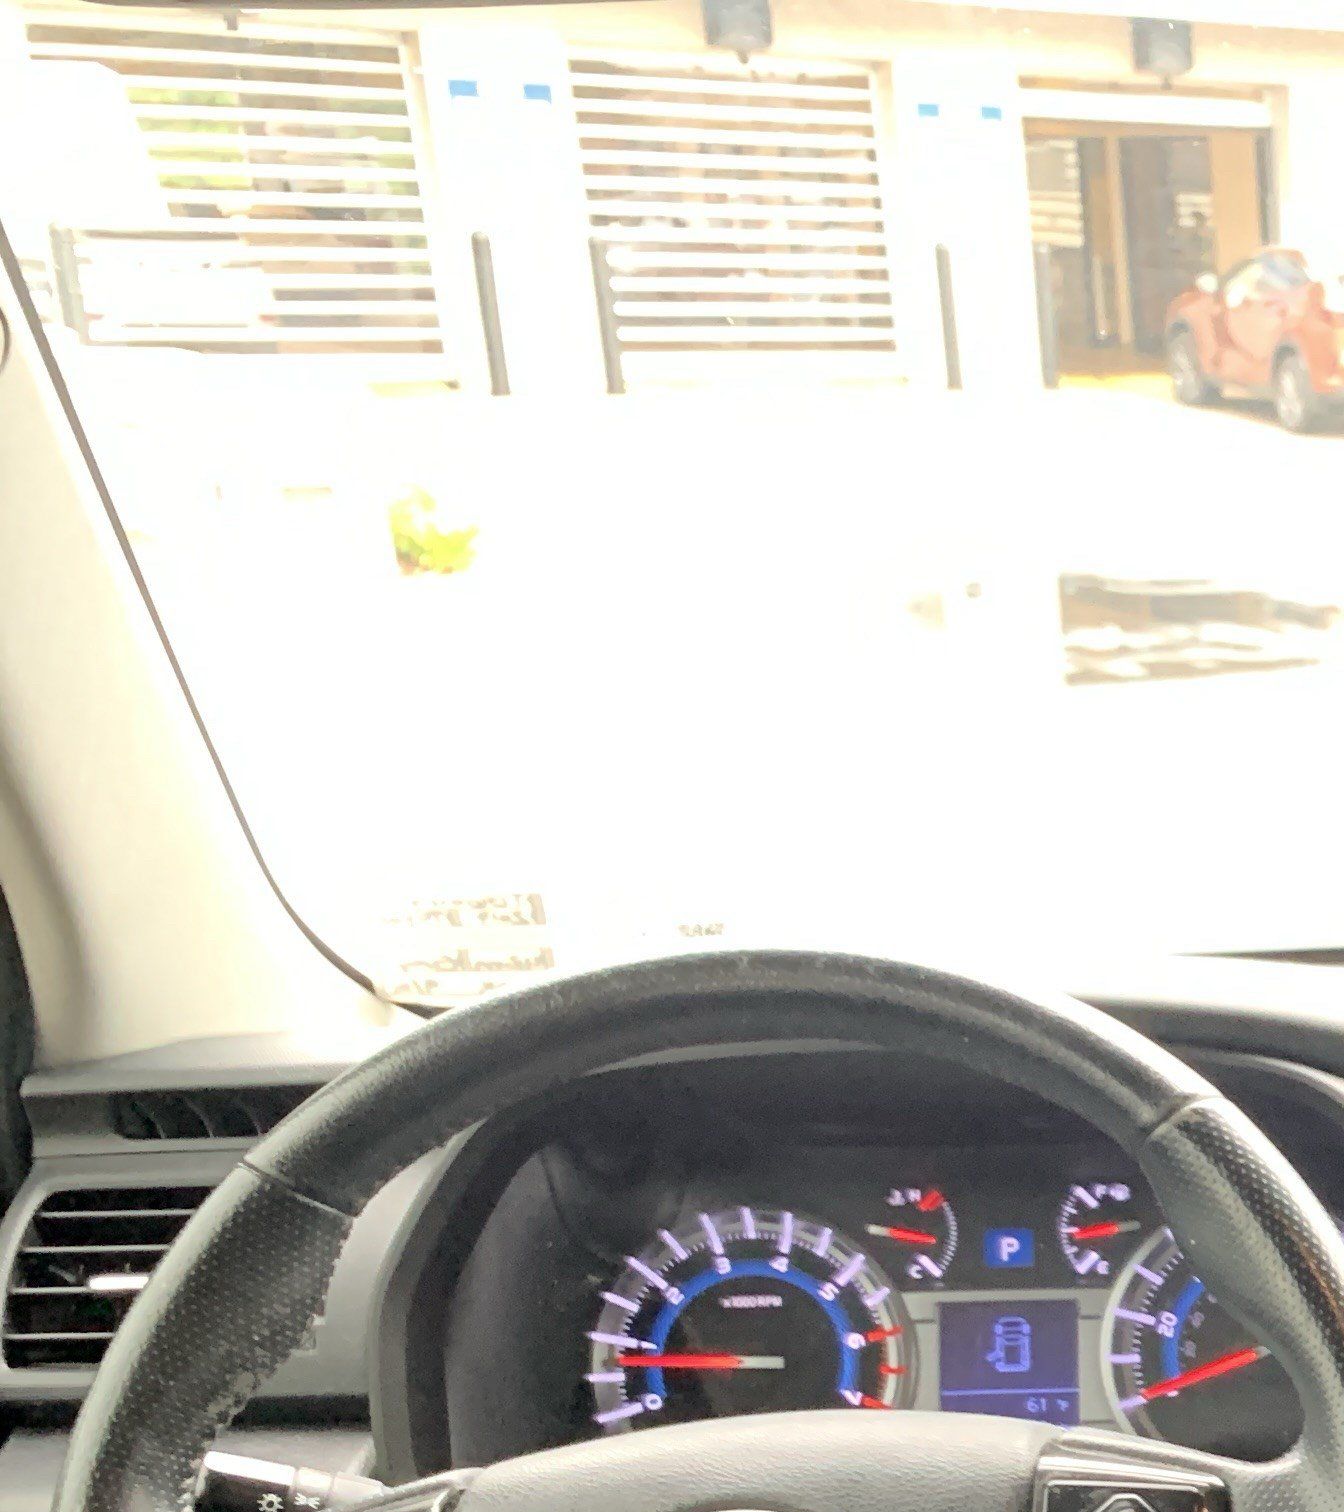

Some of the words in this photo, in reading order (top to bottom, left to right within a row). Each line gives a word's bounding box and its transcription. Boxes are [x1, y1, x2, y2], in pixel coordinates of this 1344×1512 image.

[999, 1236, 1021, 1263] P
[769, 1256, 789, 1273] 4
[817, 1281, 840, 1301] 5
[1157, 1310, 1178, 1338] 20
[846, 1332, 866, 1350] 6
[645, 1393, 663, 1411] 0
